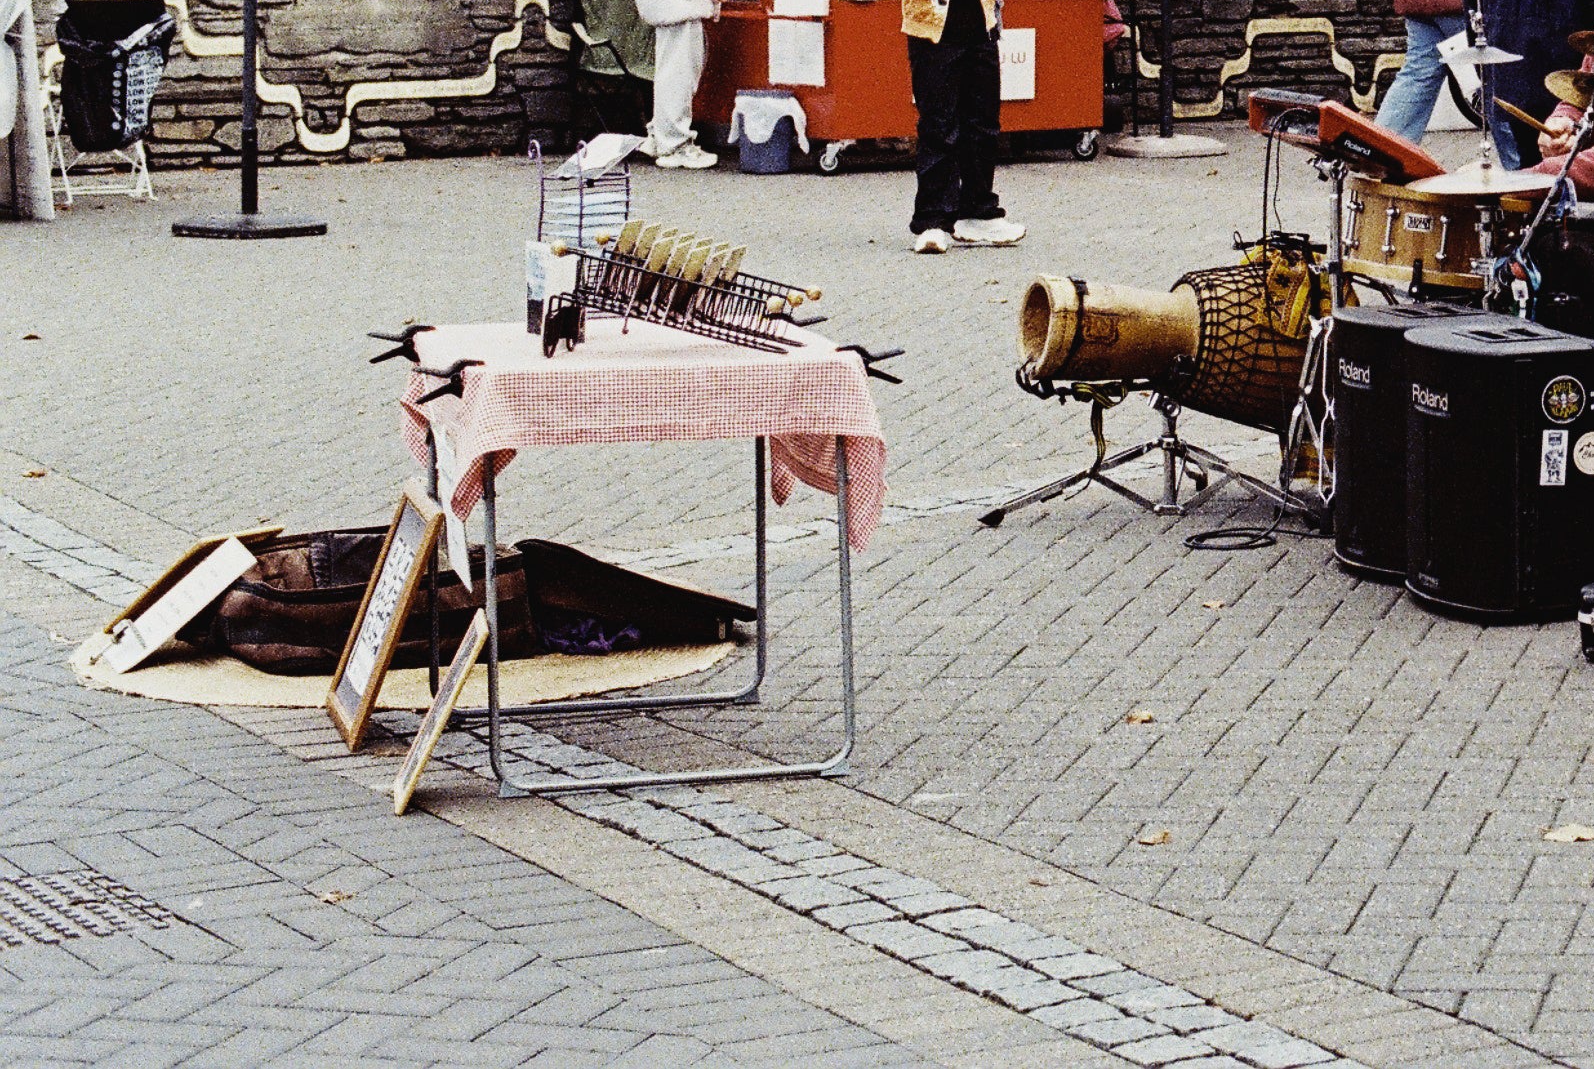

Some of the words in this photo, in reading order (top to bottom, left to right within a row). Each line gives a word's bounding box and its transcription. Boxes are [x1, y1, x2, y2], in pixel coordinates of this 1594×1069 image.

[1344, 139, 1371, 156] Roland
[1339, 357, 1370, 383] Roland
[1412, 383, 1448, 411] Roland
